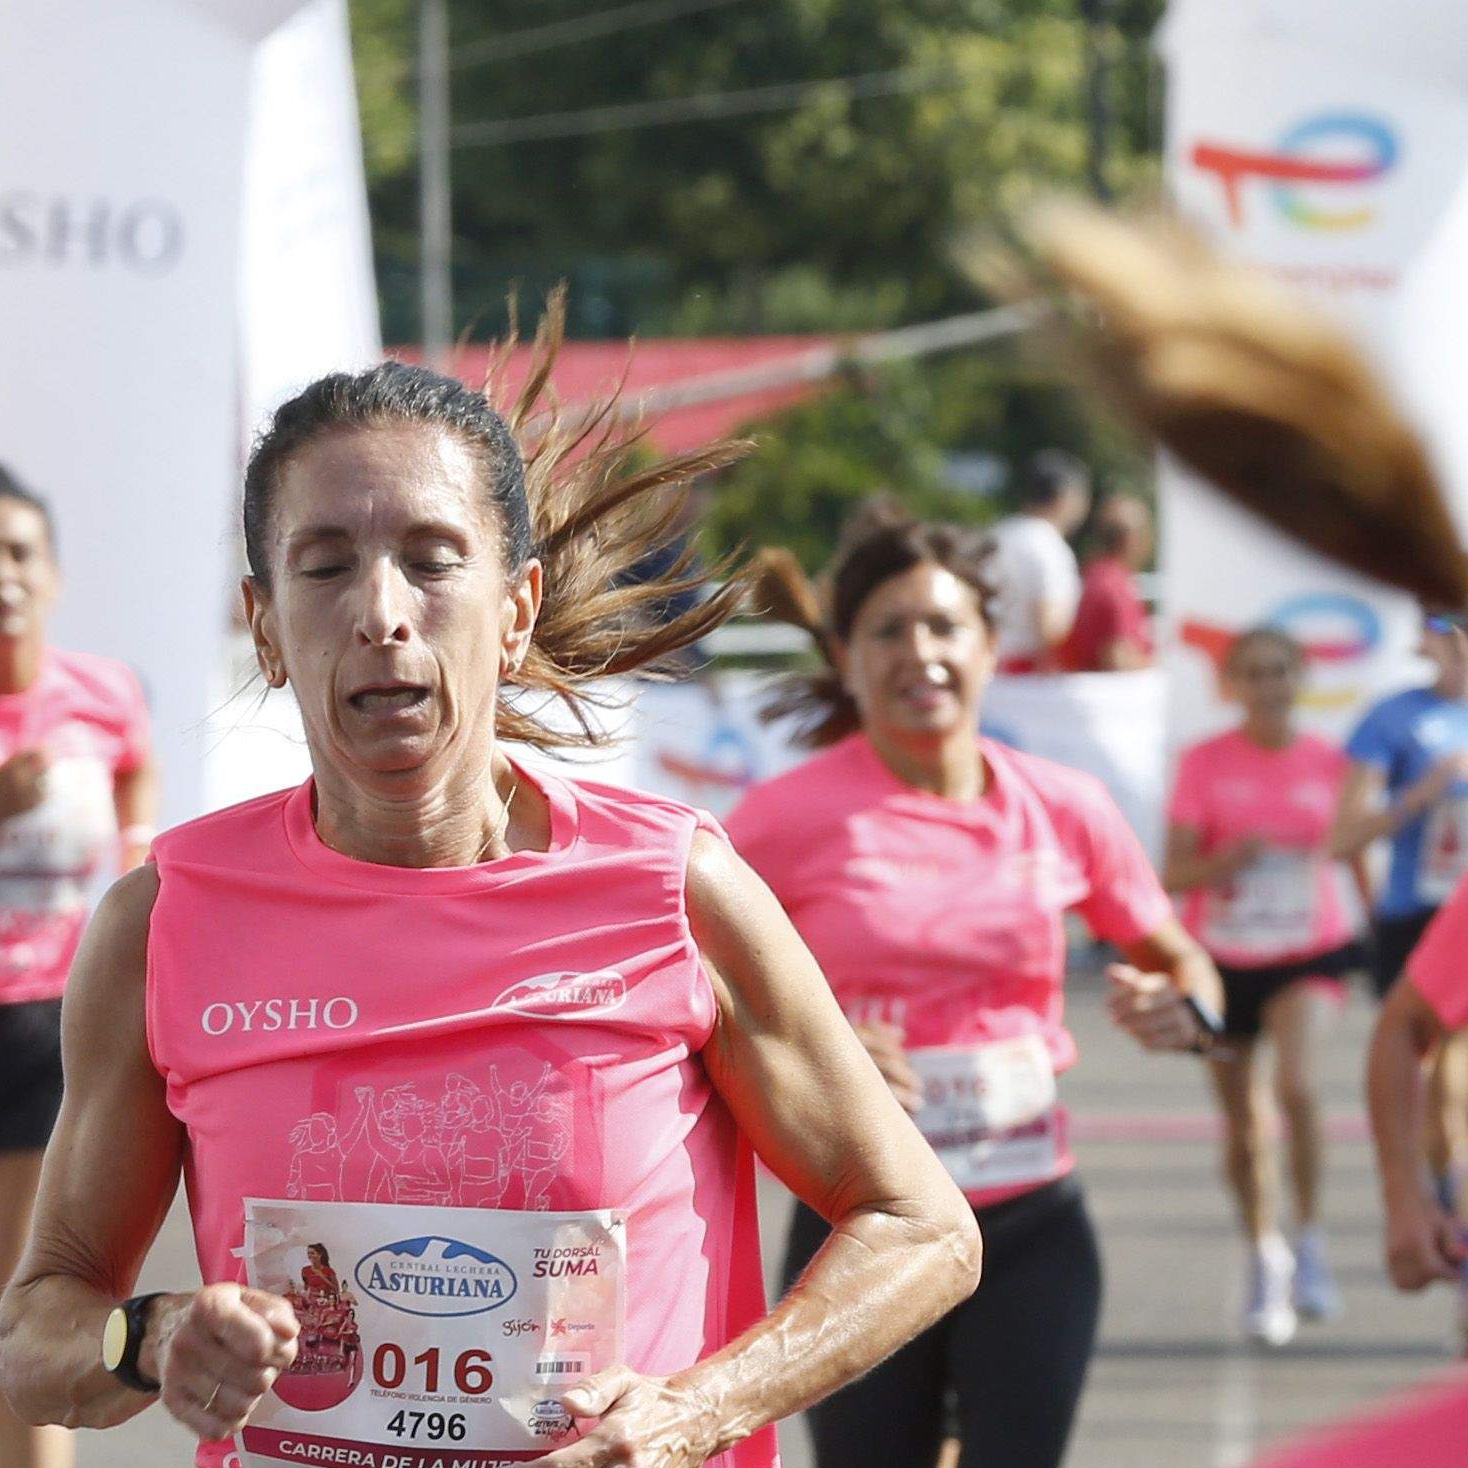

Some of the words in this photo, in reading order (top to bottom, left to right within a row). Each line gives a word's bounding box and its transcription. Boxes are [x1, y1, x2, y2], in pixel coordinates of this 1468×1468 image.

[201, 997, 358, 1036] OYSHO
[533, 1248, 551, 1259] TU
[553, 1246, 601, 1259] DORSAL
[368, 1262, 505, 1298] ASTURIANA
[390, 1260, 441, 1272] CENTRAL
[446, 1265, 500, 1275] LECHERA
[532, 1258, 599, 1278] SUMA
[502, 1319, 541, 1337] gijón
[372, 1342, 493, 1395] 016
[387, 1410, 466, 1441] 4796
[279, 1440, 376, 1468] CARRERA
